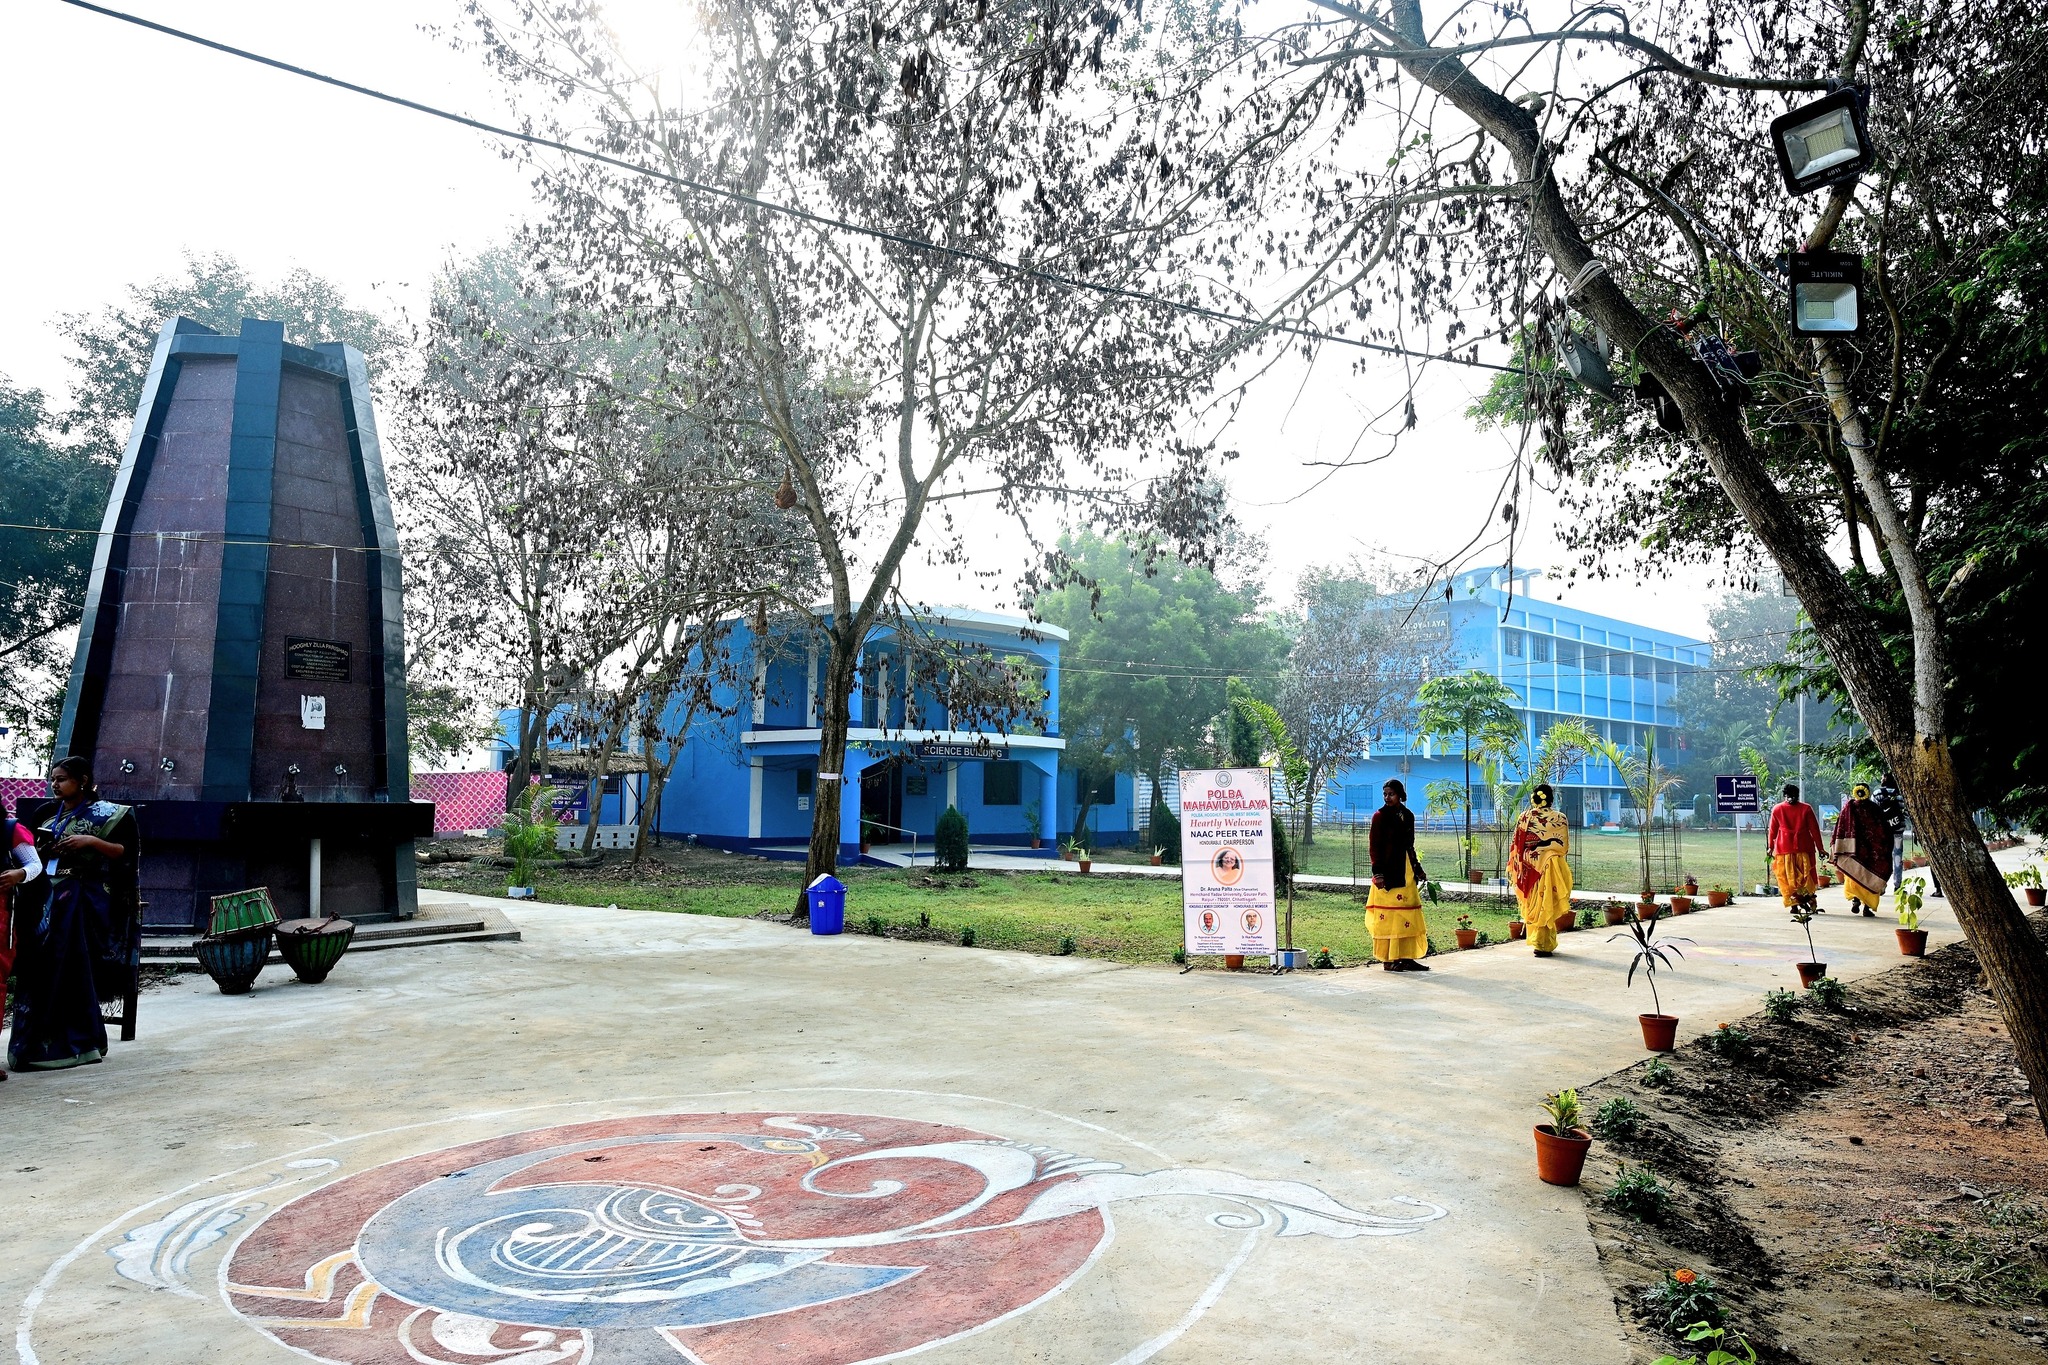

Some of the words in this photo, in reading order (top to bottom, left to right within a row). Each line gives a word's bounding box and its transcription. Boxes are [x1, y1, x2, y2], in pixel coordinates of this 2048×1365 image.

[289, 642, 312, 651] HOOGHLY
[924, 746, 962, 756] SCIENCE
[963, 747, 1003, 758] BUILDING
[1207, 789, 1244, 800] POLBA
[1183, 800, 1269, 812] MAHAVIDYALAYA
[1190, 818, 1222, 829] Heartly
[1224, 818, 1263, 827] Welcome
[1190, 830, 1214, 838] NAAC
[1239, 829, 1263, 837] TEAM
